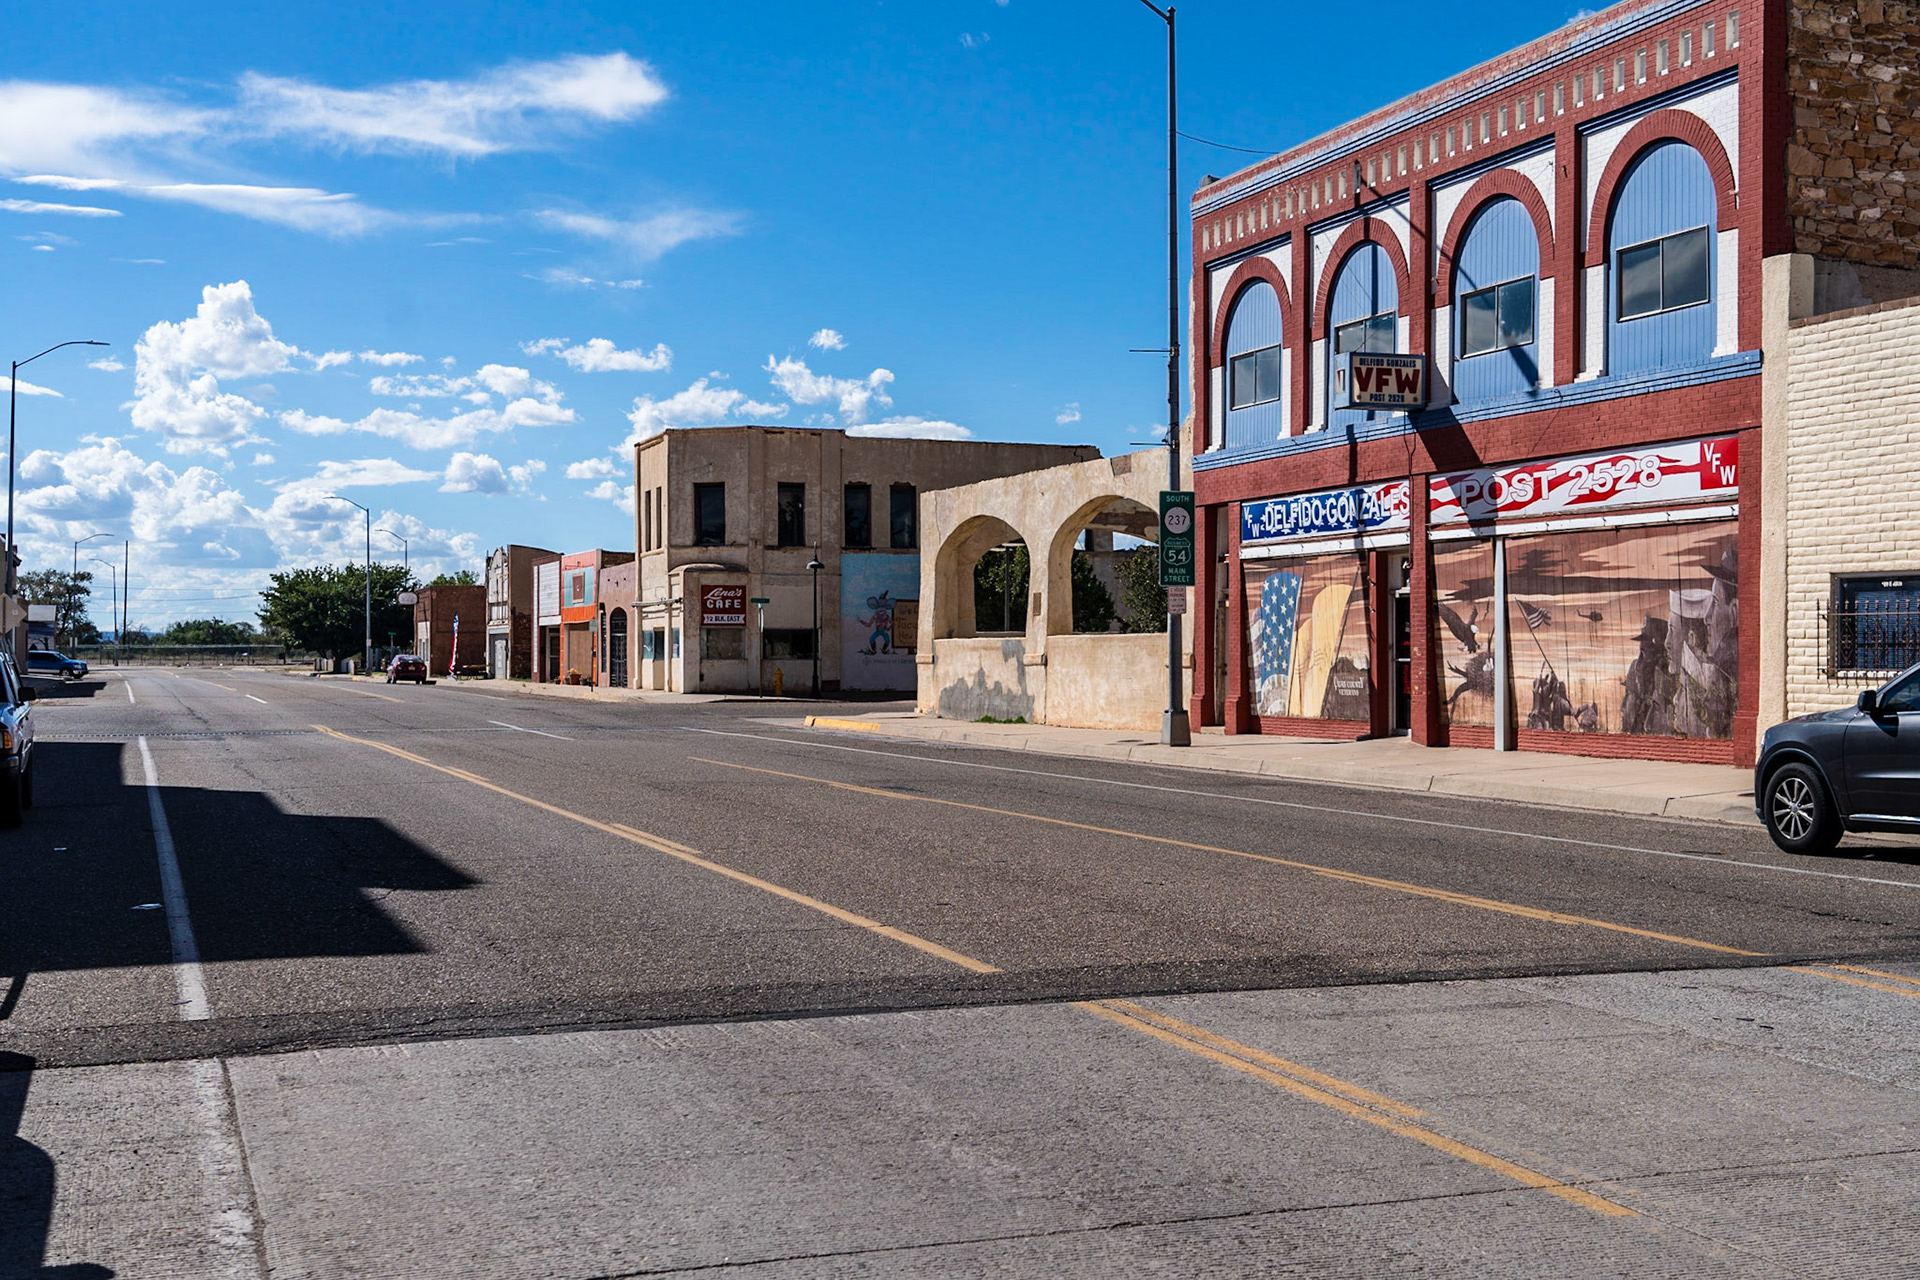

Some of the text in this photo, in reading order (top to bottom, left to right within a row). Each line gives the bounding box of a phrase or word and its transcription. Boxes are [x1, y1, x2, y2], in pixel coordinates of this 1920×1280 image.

[1359, 358, 1416, 368] DELFIDO GONZALES
[1354, 366, 1420, 394] VFW
[1369, 393, 1405, 403] POST 2528
[1460, 454, 1663, 508] POST 2528
[1264, 485, 1410, 531] DELFIDO GONZALES
[1168, 515, 1187, 525] 237
[1168, 550, 1186, 562] 54
[703, 587, 742, 599] Lena's
[706, 599, 741, 608] CAFE
